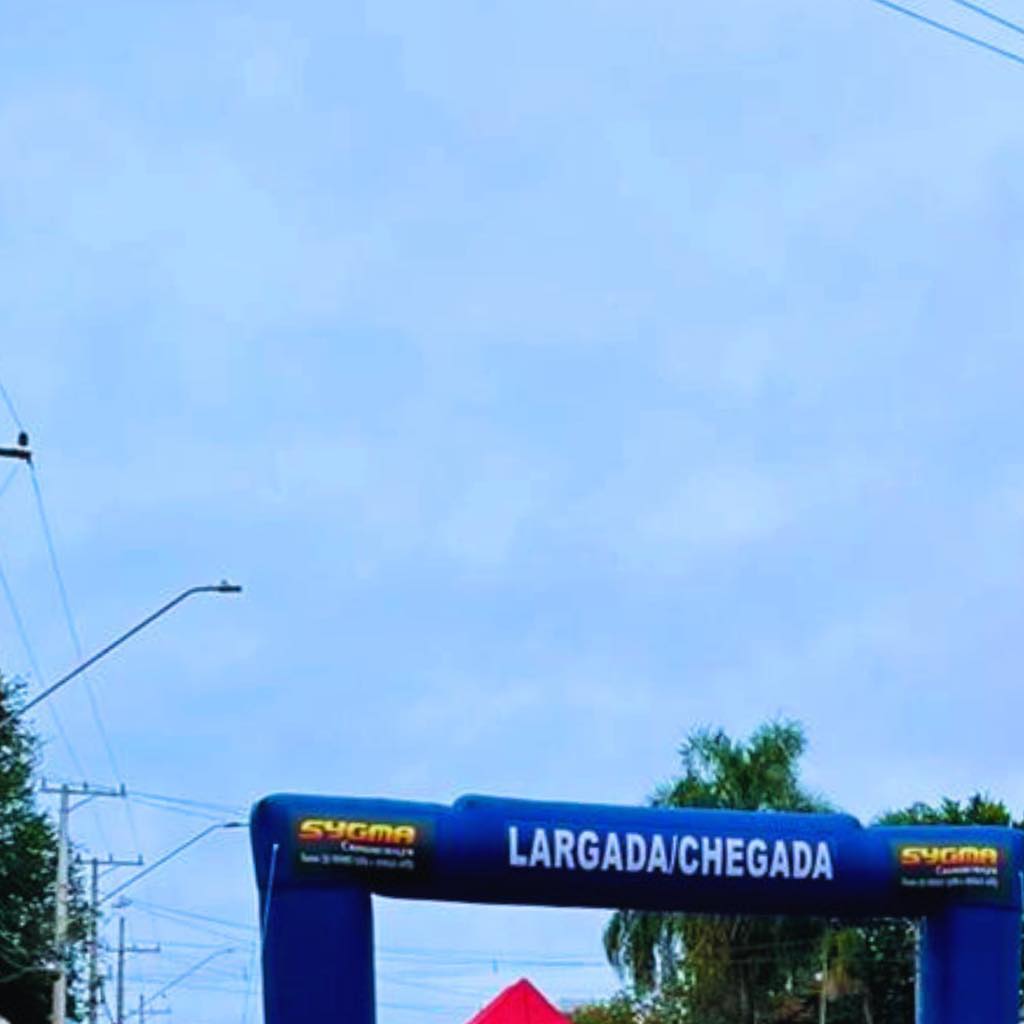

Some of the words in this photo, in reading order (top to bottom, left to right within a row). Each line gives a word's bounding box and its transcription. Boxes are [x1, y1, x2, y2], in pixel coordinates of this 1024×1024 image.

[299, 819, 416, 843] SYGMA
[508, 826, 834, 881] LARGADA/CHEGADA
[901, 846, 998, 865] SYGMA
